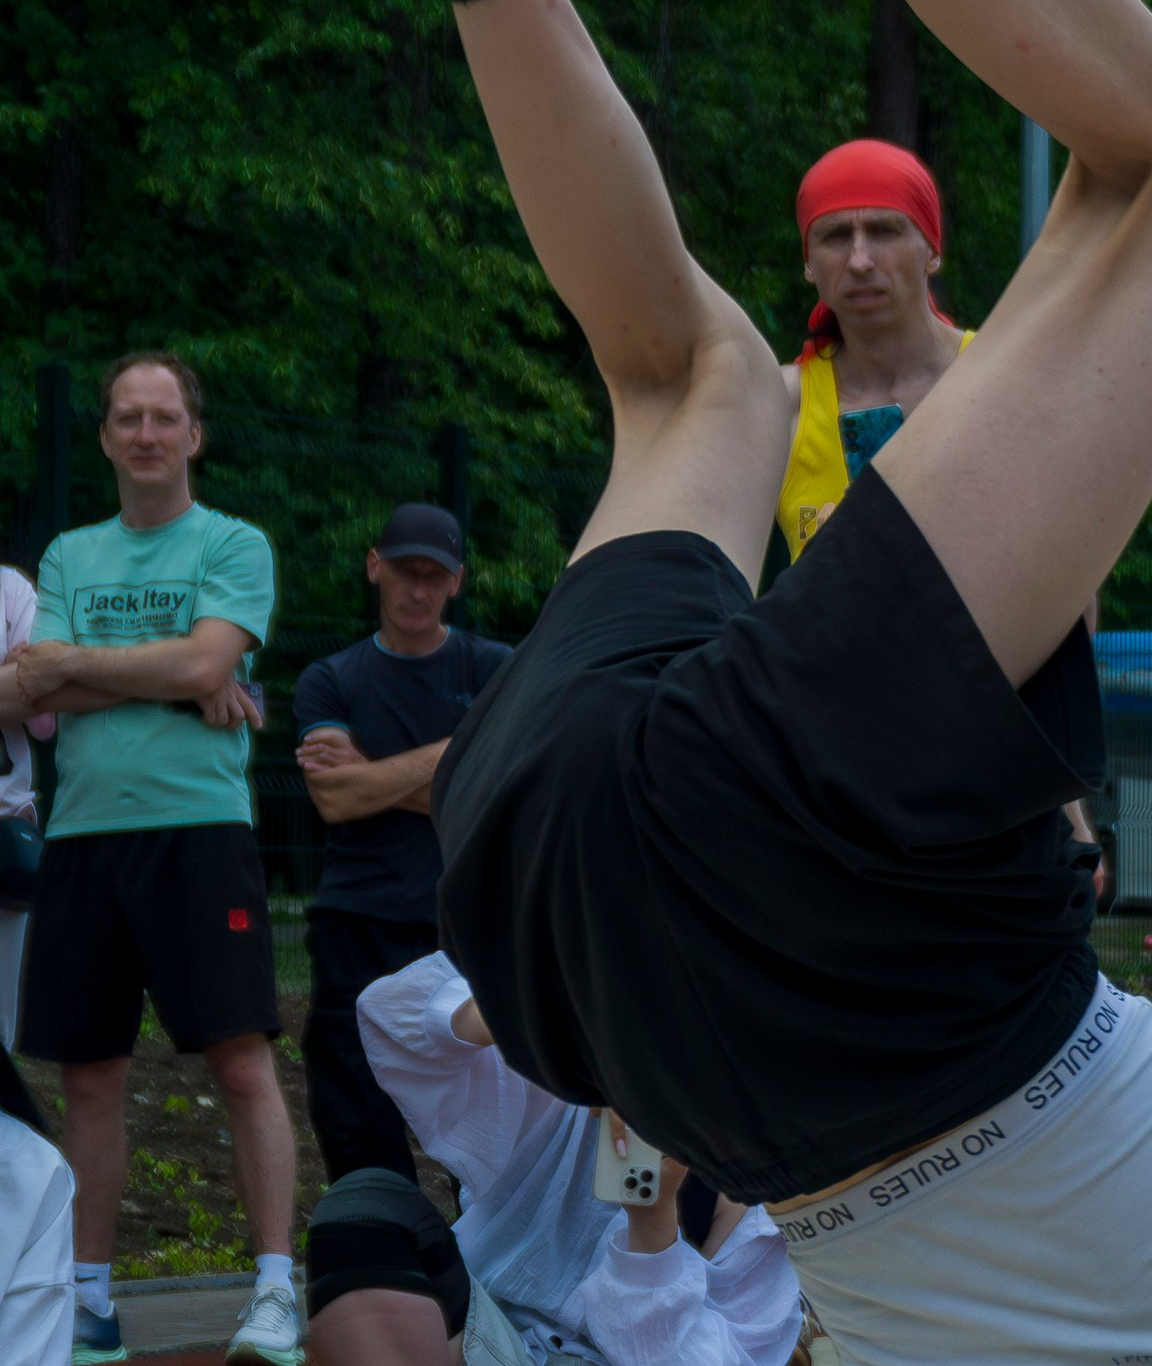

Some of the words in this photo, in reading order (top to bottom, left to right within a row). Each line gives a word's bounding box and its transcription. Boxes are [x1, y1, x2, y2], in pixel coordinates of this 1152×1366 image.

[84, 591, 139, 614] Jack
[1094, 1000, 1120, 1034] NO
[1024, 1028, 1103, 1110] RULES
[961, 1120, 1007, 1156] NO
[869, 1147, 962, 1207] RULES
[815, 1202, 856, 1231] NO
